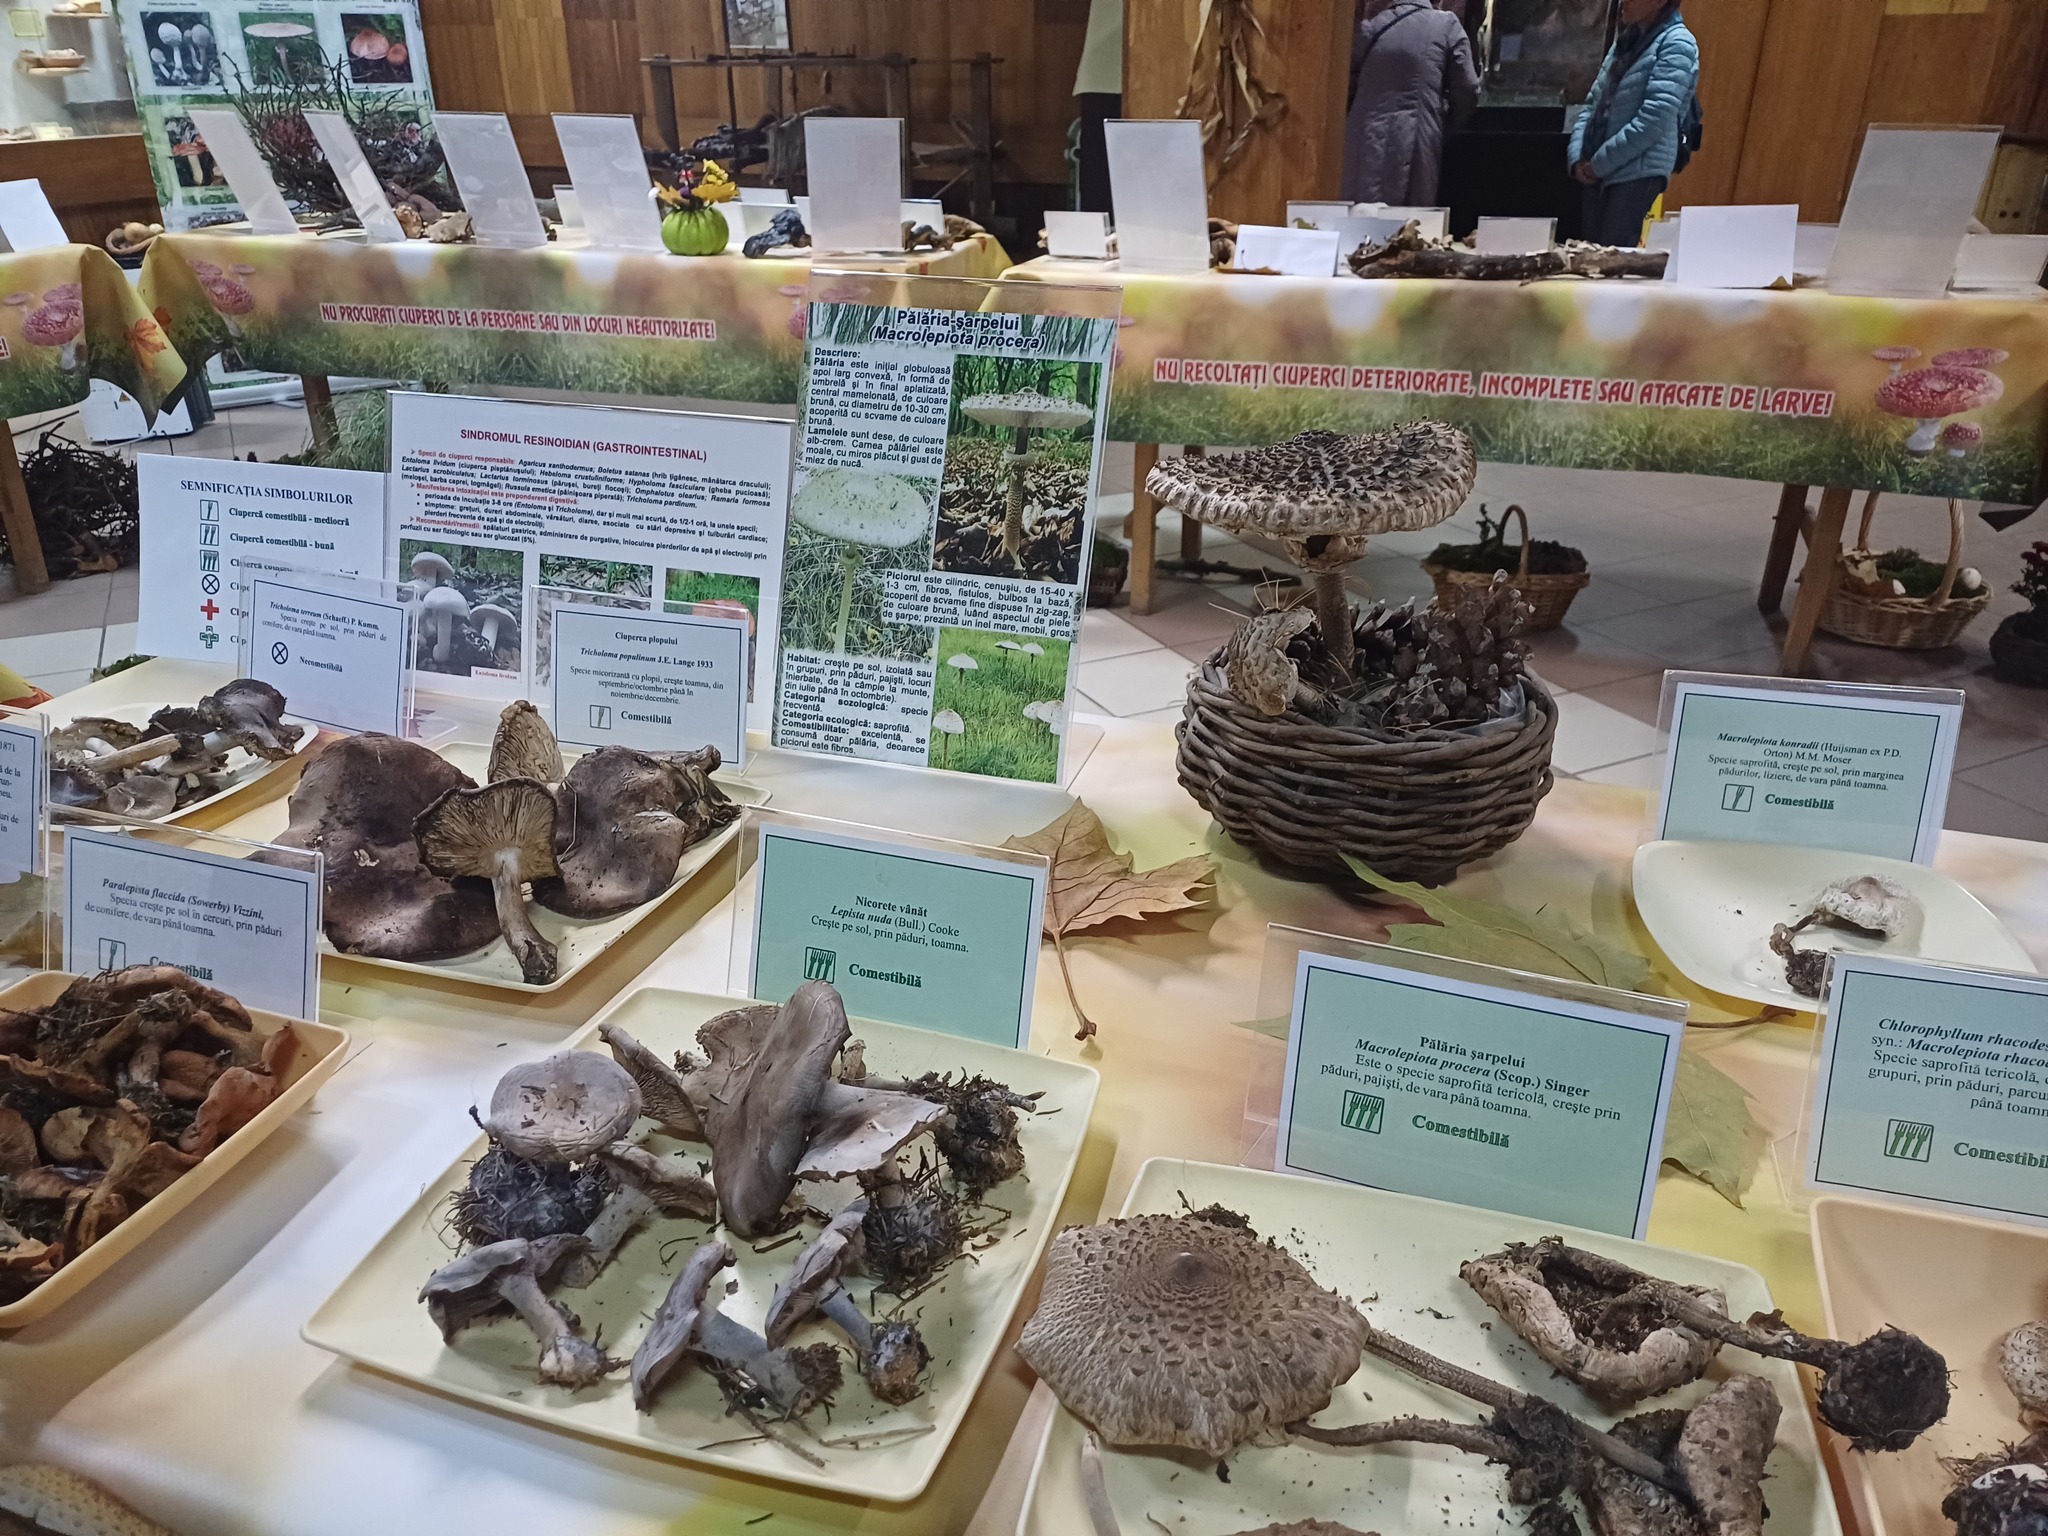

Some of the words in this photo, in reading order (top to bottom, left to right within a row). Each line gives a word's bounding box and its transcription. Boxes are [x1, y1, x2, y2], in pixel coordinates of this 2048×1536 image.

[322, 305, 337, 321] NU
[398, 309, 444, 326] CIUPERCI
[447, 311, 461, 327] DE
[464, 312, 478, 328] LA
[481, 312, 535, 330] PERSOANE
[539, 315, 558, 331] SAU
[562, 316, 581, 332] DIN
[584, 317, 622, 334] LOCURI
[626, 319, 715, 338] NEAUTORIZATE!
[1156, 359, 1177, 380] NU
[1273, 365, 1345, 389] CIUPERCI
[1351, 370, 1480, 396] DETERIORATE,
[1482, 376, 1591, 402] INCOMPLETE
[1598, 383, 1633, 404] SAU
[1639, 385, 1722, 409] ATACATE
[1729, 390, 1760, 411] DE
[1761, 391, 1834, 415] LARVE!
[461, 429, 520, 444] SINDROMUL
[523, 435, 590, 451] RESINOIDIAN
[592, 441, 707, 463] (GASTROINTESTINAL)
[831, 904, 864, 920] Lepista
[867, 913, 892, 924] nuda
[894, 915, 925, 933] (Bull.)
[928, 921, 959, 936] Cooke
[855, 895, 896, 912] Nicorete
[899, 904, 928, 917] vânăt
[842, 922, 853, 933] pe
[855, 923, 871, 937] sol,
[874, 927, 893, 939] prin
[895, 930, 928, 948] păduri,
[931, 935, 969, 952] toamna.
[849, 965, 922, 987] Comestibilă
[1419, 1036, 1466, 1056] Pălăria
[1879, 1019, 1983, 1042] Chlorophyllum
[1871, 1037, 1901, 1049] syn.:
[1907, 1039, 1999, 1061] Macrolepiota
[1355, 1038, 1437, 1065] Macrolepiota
[1440, 1059, 1490, 1076] procera
[1493, 1066, 1540, 1090] (Scop.)
[1544, 1077, 1590, 1098] Singer
[1868, 1067, 1920, 1085] grupuri,
[1925, 1074, 1952, 1087] prin
[1956, 1078, 2003, 1097] păduri,
[2008, 1087, 2048, 1100] parcu
[1873, 1049, 1917, 1065] Specie
[1921, 1059, 1980, 1074] saprofită
[1985, 1065, 2039, 1086] tericolă,
[1321, 1064, 1361, 1086] păduri,
[1405, 1081, 1420, 1094] de
[1423, 1088, 1448, 1100] vara
[1450, 1092, 1479, 1107] până
[1482, 1097, 1532, 1119] toamna.
[1355, 1054, 1381, 1070] Este
[1396, 1066, 1434, 1081] specie
[1438, 1075, 1492, 1093] saprofită
[1497, 1083, 1546, 1108] tericolă,
[1594, 1106, 1621, 1120] prin
[1970, 1098, 2002, 1112] până
[1412, 1116, 1510, 1148] Comestibilă
